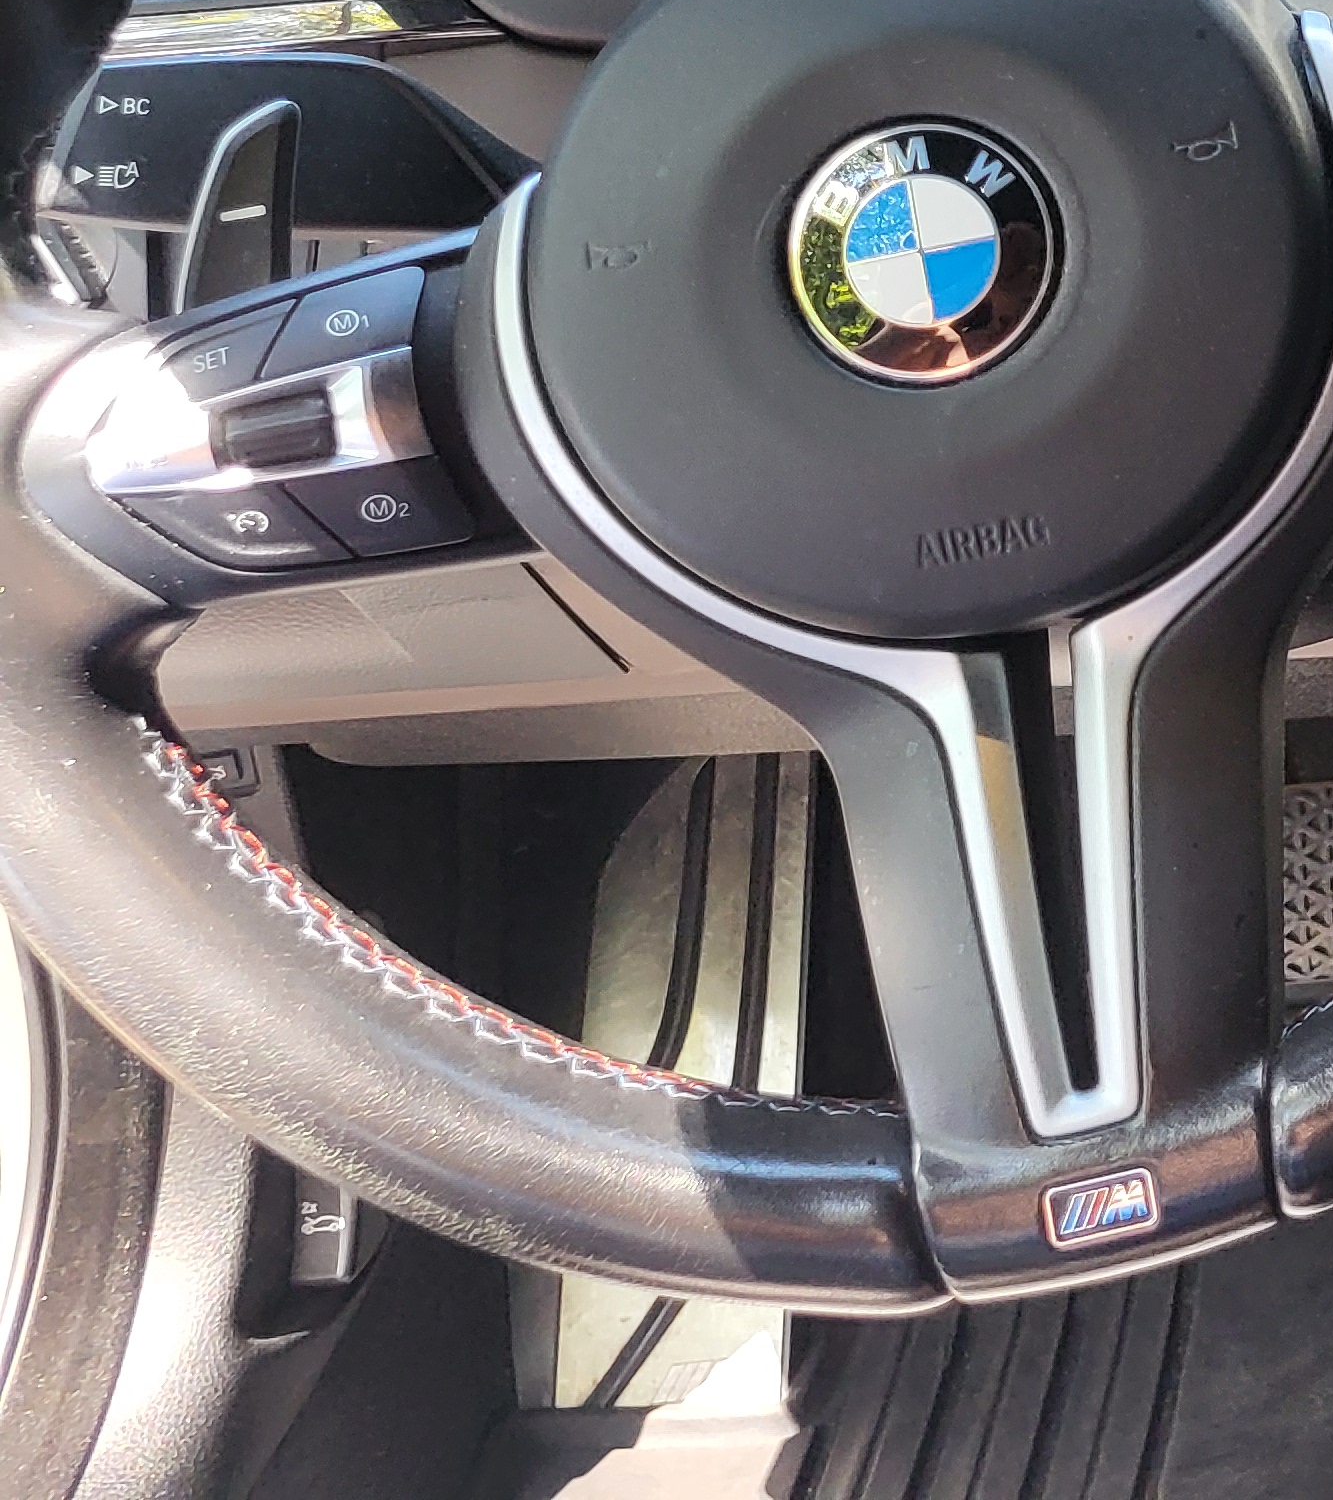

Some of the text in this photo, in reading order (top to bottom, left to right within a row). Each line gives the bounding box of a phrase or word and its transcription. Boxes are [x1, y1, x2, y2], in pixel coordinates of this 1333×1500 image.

[122, 97, 151, 116] BC
[193, 347, 230, 374] SET
[917, 514, 1051, 569] AIRBAG
